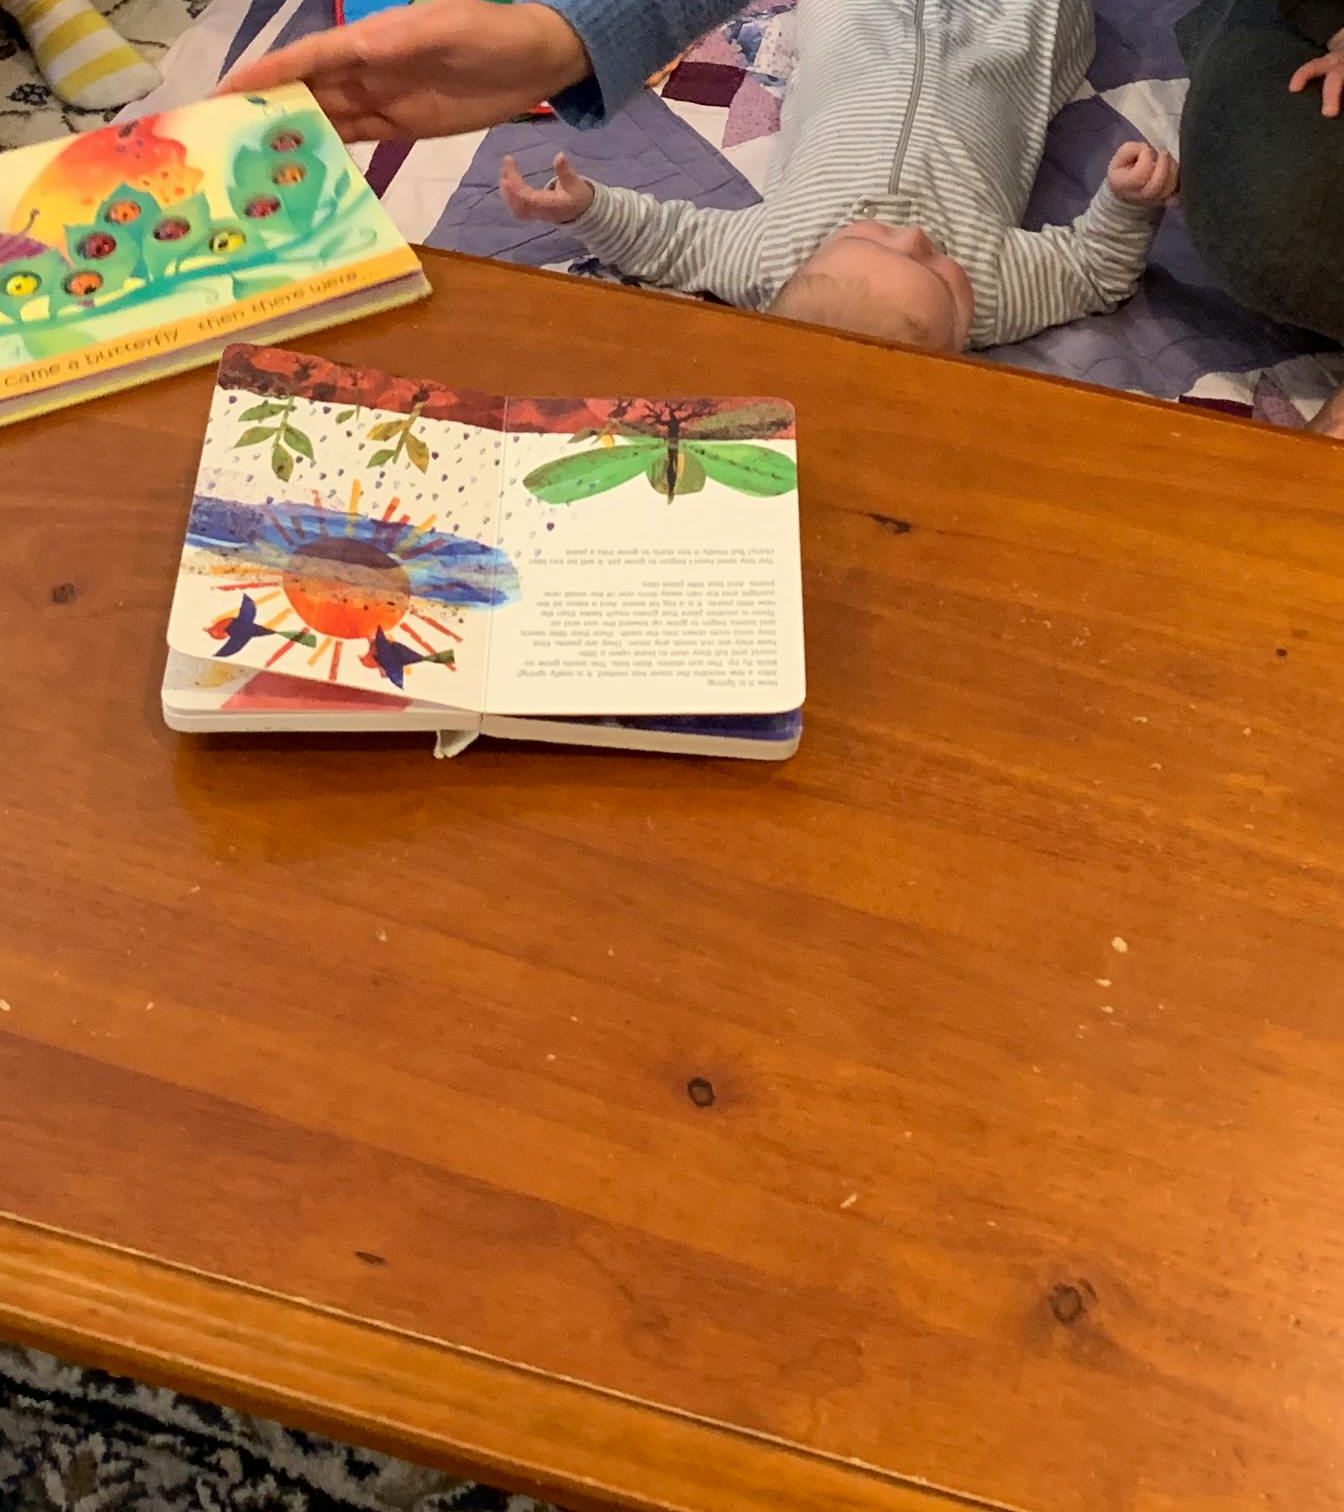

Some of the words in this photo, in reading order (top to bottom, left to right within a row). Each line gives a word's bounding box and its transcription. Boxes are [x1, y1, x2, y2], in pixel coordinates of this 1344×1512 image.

[4, 363, 60, 387] came
[68, 359, 81, 372] a
[198, 310, 246, 331] then
[252, 289, 305, 314] there
